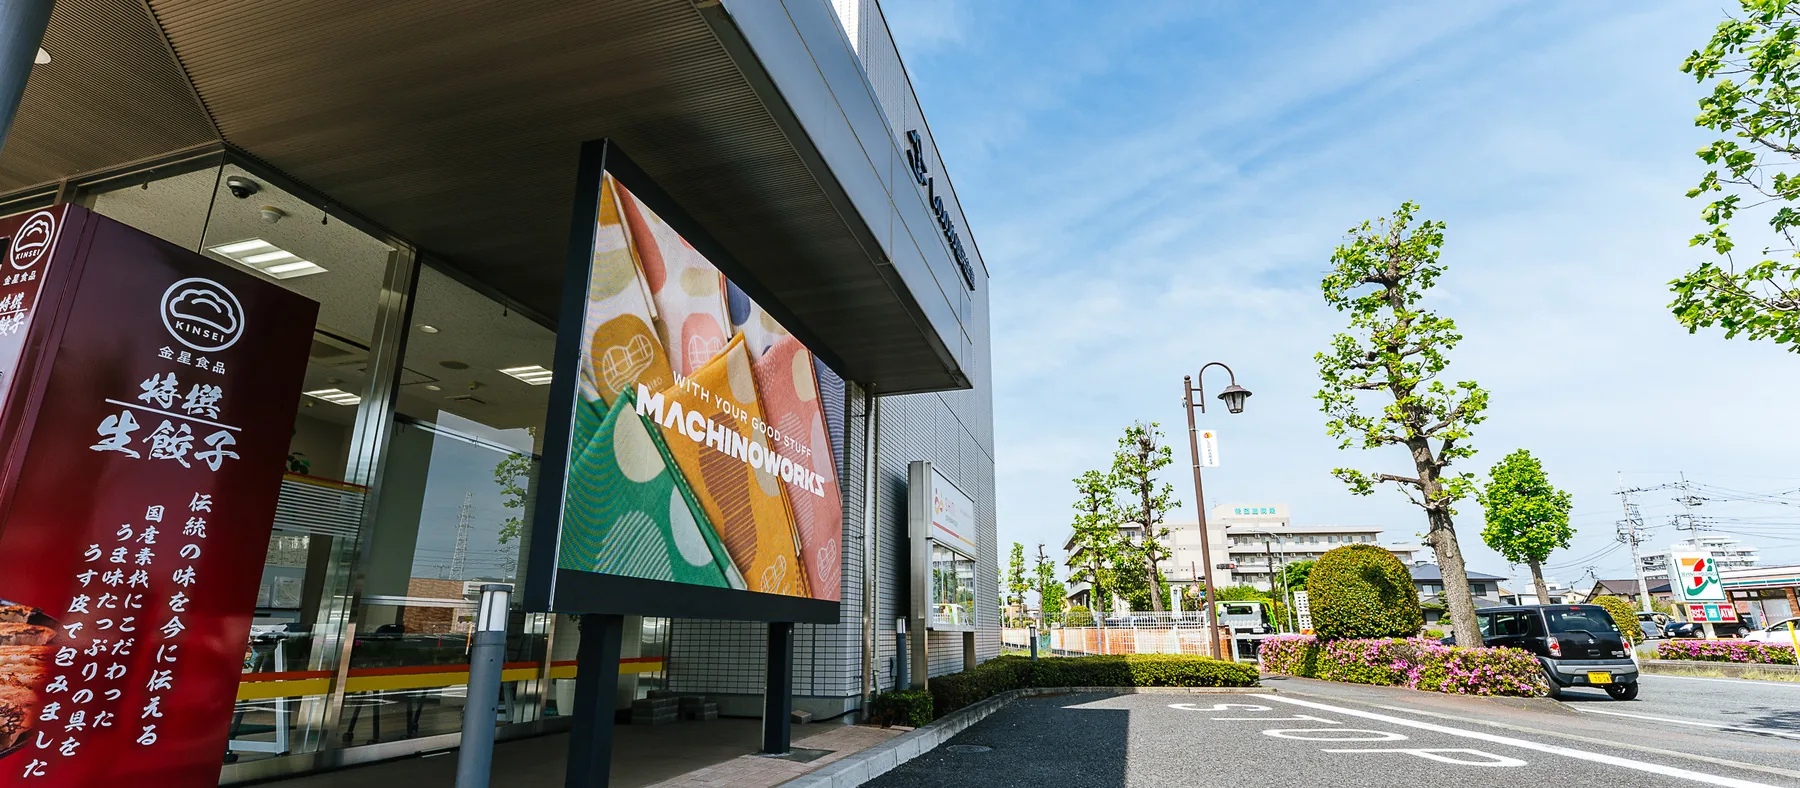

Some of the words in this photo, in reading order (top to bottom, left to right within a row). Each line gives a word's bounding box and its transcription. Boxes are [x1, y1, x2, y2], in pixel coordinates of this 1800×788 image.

[3, 270, 37, 287] 金星食品
[15, 249, 42, 261] KINSEI
[158, 345, 227, 375] 金星食品
[175, 320, 226, 344] KINSEI
[137, 371, 224, 420] 特撰
[673, 371, 710, 403] WITH
[715, 394, 748, 424] YOUR
[751, 416, 781, 442] GOOD
[784, 435, 812, 458] STUFF
[89, 410, 241, 472] 生餃子
[635, 382, 825, 499] MACHINOWORKS
[59, 523, 134, 757] うま味たっぷりの具を
[92, 504, 165, 728] 国産素材にこだわった
[136, 491, 213, 747] 伝統の味を今に伝える
[1720, 608, 1735, 618] ATM
[22, 543, 102, 779] うす皮で包みました
[1168, 703, 1528, 767] STOP
